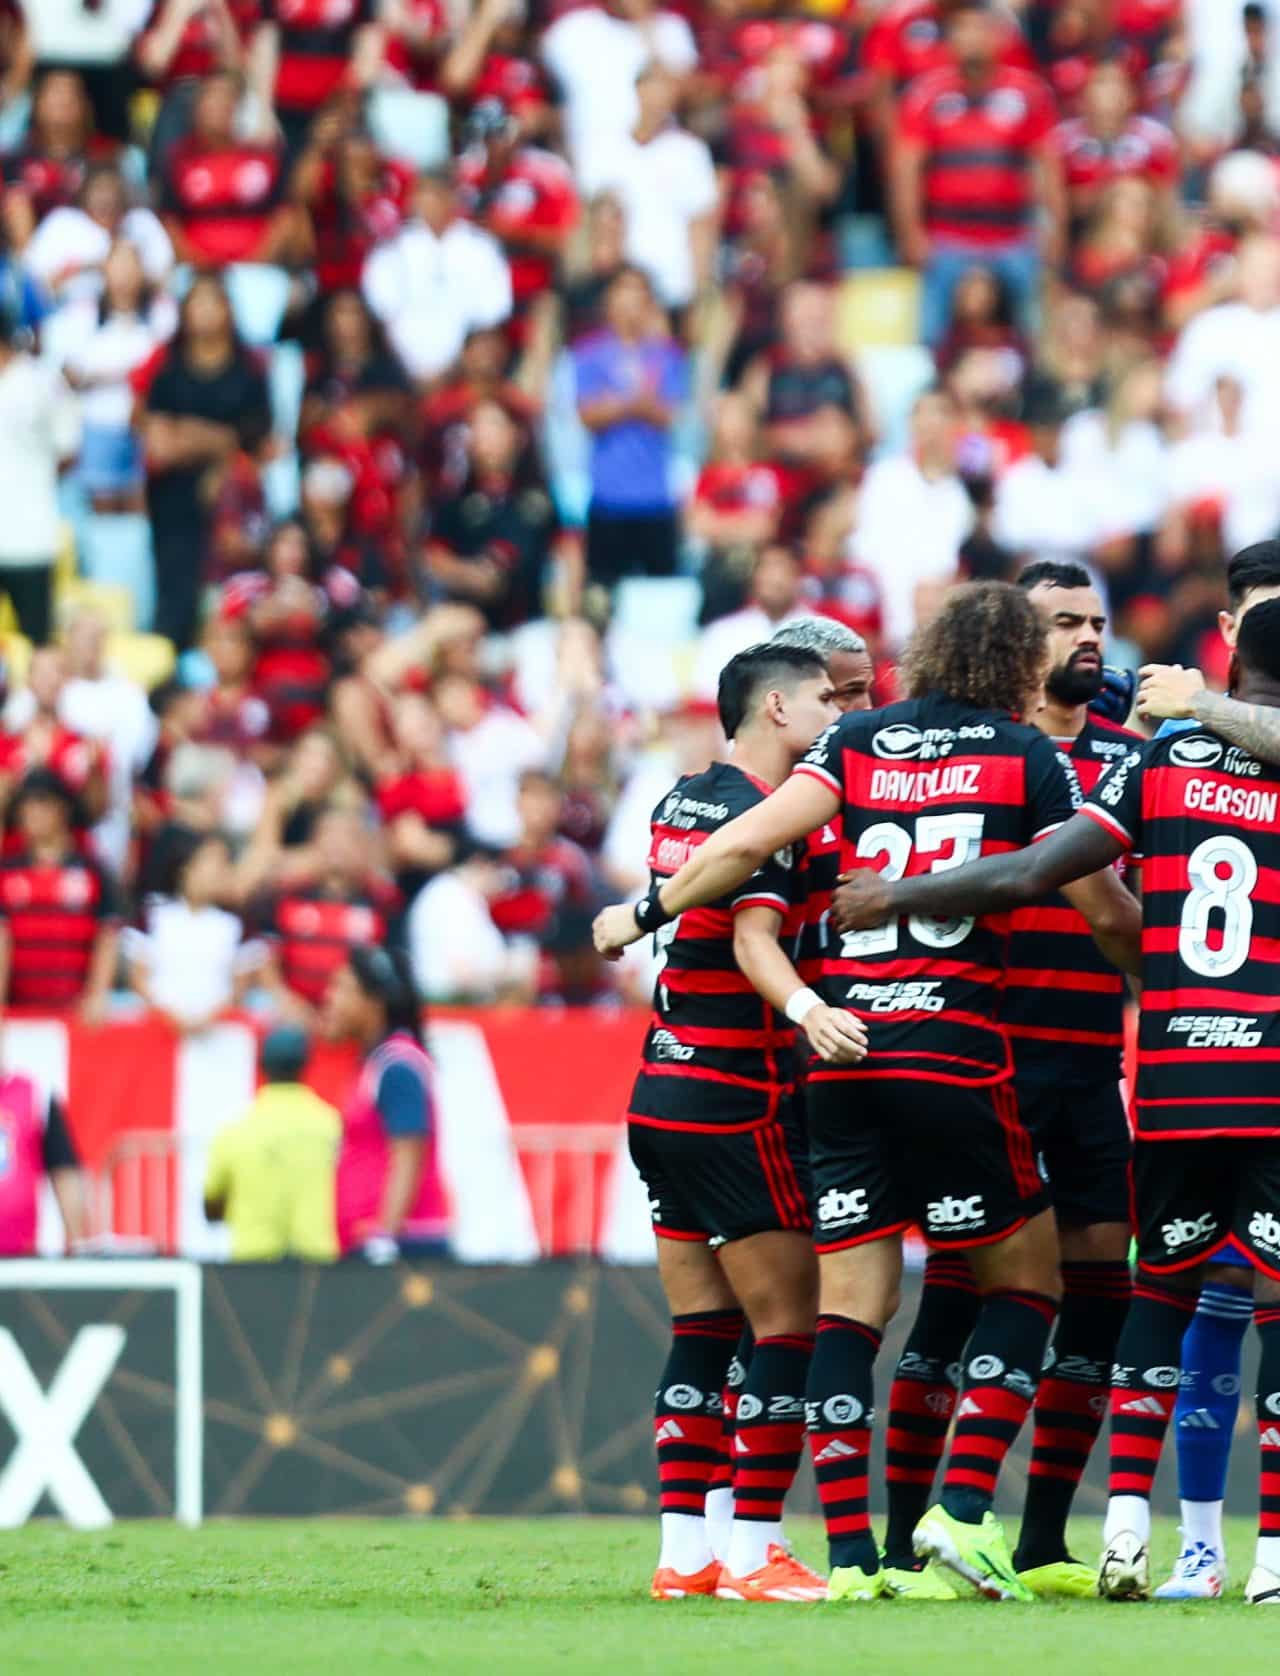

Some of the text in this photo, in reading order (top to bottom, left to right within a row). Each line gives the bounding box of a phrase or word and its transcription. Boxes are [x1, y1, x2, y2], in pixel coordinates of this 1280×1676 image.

[927, 764, 982, 798] LUIZ
[1224, 757, 1262, 776] livre
[1184, 778, 1278, 823] GERSON
[1178, 835, 1258, 977] 8
[1167, 1015, 1258, 1033] ASSIST
[1186, 1032, 1263, 1048] CARD
[818, 1188, 869, 1221] abc
[927, 1194, 985, 1224] abc
[1161, 1211, 1218, 1247] abc
